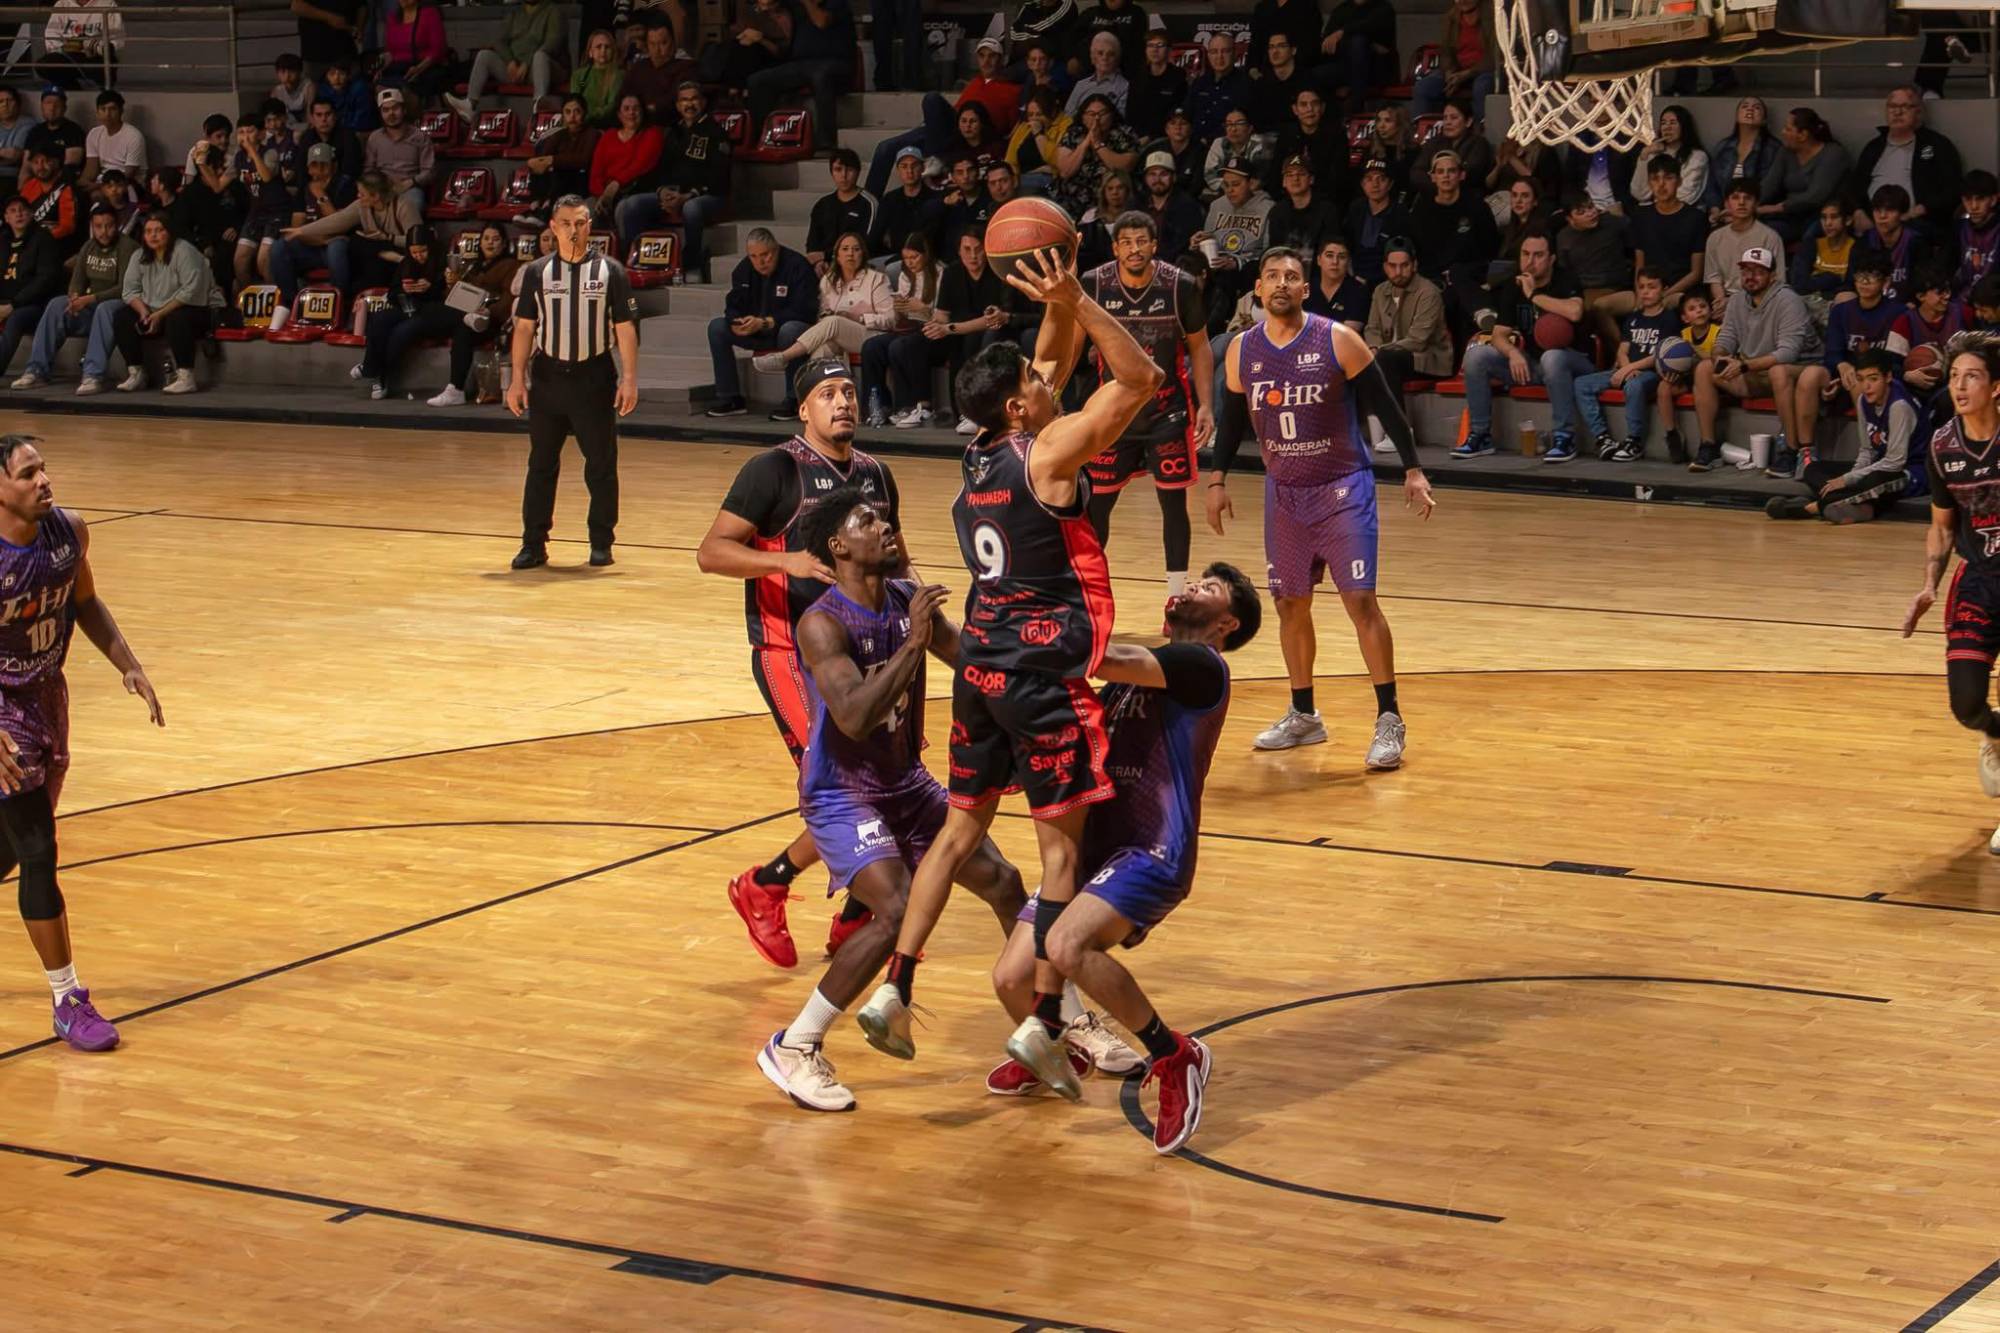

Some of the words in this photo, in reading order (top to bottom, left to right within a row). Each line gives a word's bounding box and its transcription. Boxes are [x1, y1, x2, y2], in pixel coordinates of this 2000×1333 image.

[1197, 22, 1250, 32] SECCIÓN
[1215, 213, 1261, 237] LAKERS
[244, 292, 275, 319] 018
[308, 296, 330, 313] 019
[1297, 352, 1321, 365] LBP
[1279, 411, 1297, 440] 0
[1278, 437, 1332, 452] MADERAN
[974, 524, 1005, 581] 9
[1351, 559, 1366, 580] 0
[26, 616, 57, 655] 10
[1029, 749, 1077, 773] Sayer
